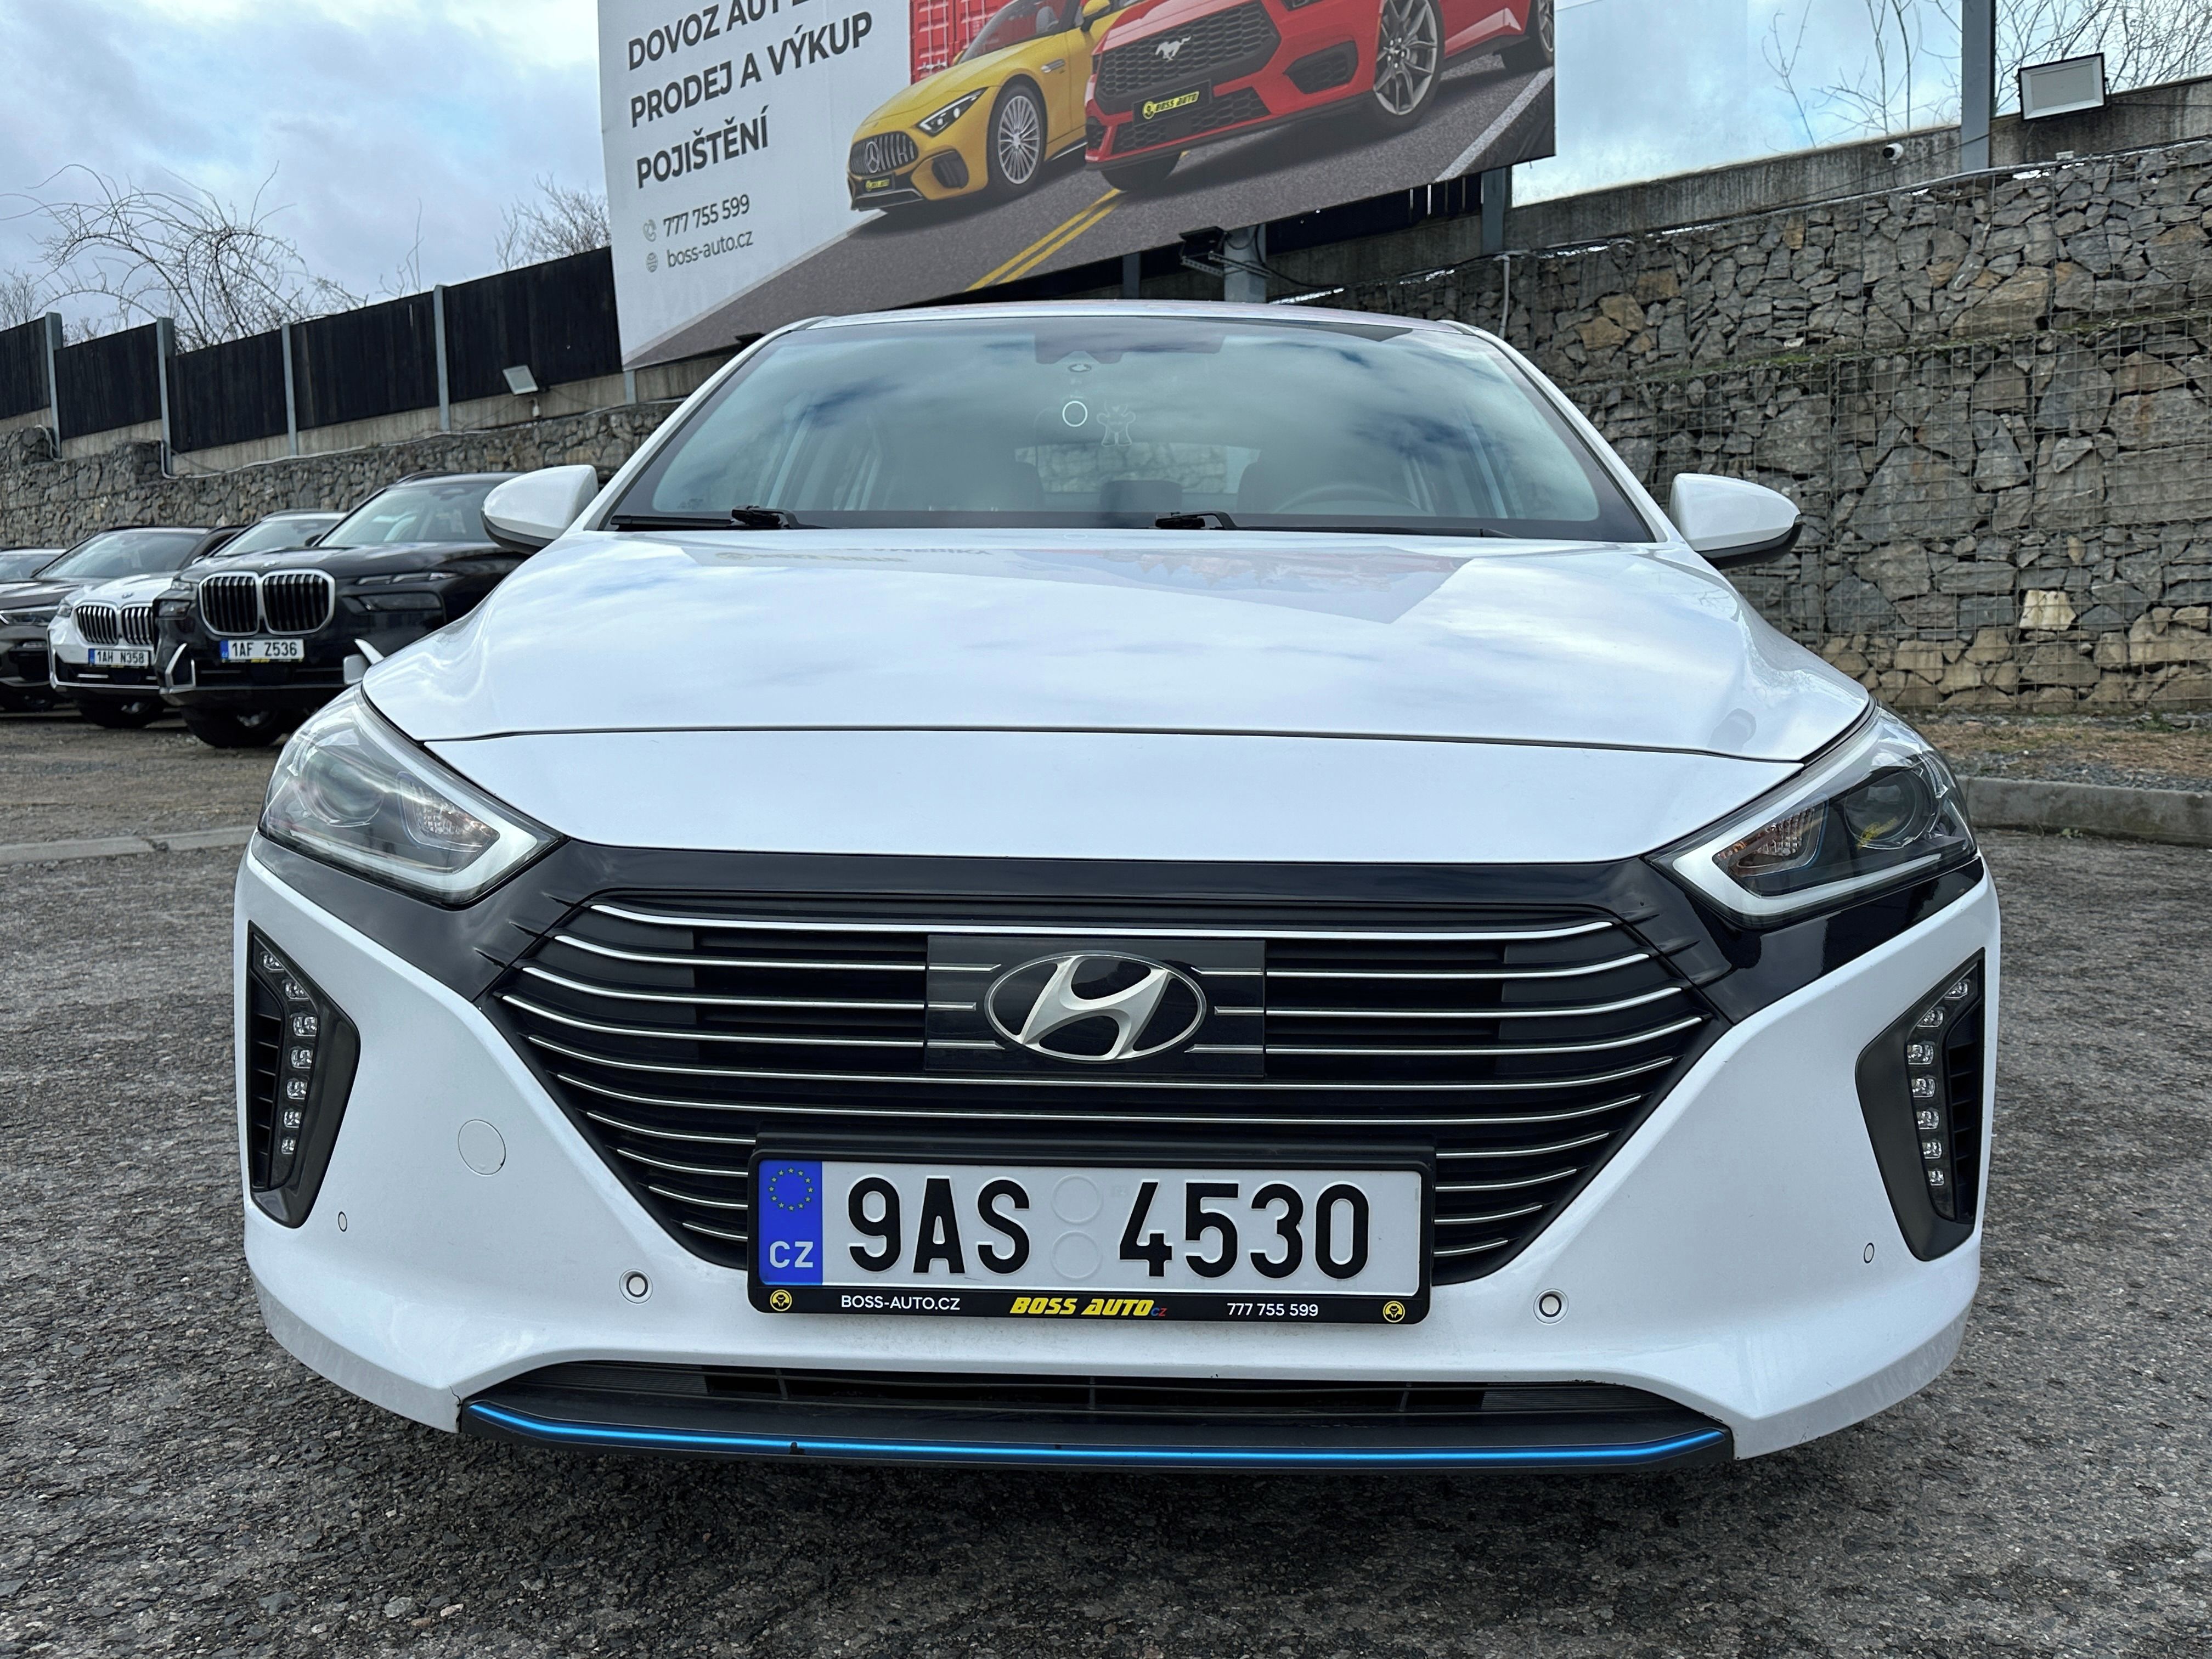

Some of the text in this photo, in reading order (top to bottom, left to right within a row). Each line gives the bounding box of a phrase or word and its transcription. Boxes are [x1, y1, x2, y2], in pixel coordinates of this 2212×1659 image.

[629, 4, 720, 71] DOVOZ
[631, 12, 872, 128] PRODEJ A VÝKUP
[636, 104, 769, 189] POJIŠTĚNÍ
[663, 194, 750, 238] 777 755 599
[667, 231, 754, 268] boss-auto.cz
[232, 641, 298, 657] 1AF Z536
[848, 1176, 1369, 1279] 9AS 4530
[769, 1240, 814, 1268] CZ
[840, 1294, 961, 1311] BOSS-AUTO.CZ
[1009, 1297, 1078, 1314] BOSS
[1081, 1298, 1155, 1316] AUTO
[1227, 1303, 1319, 1317] 777 755 599
